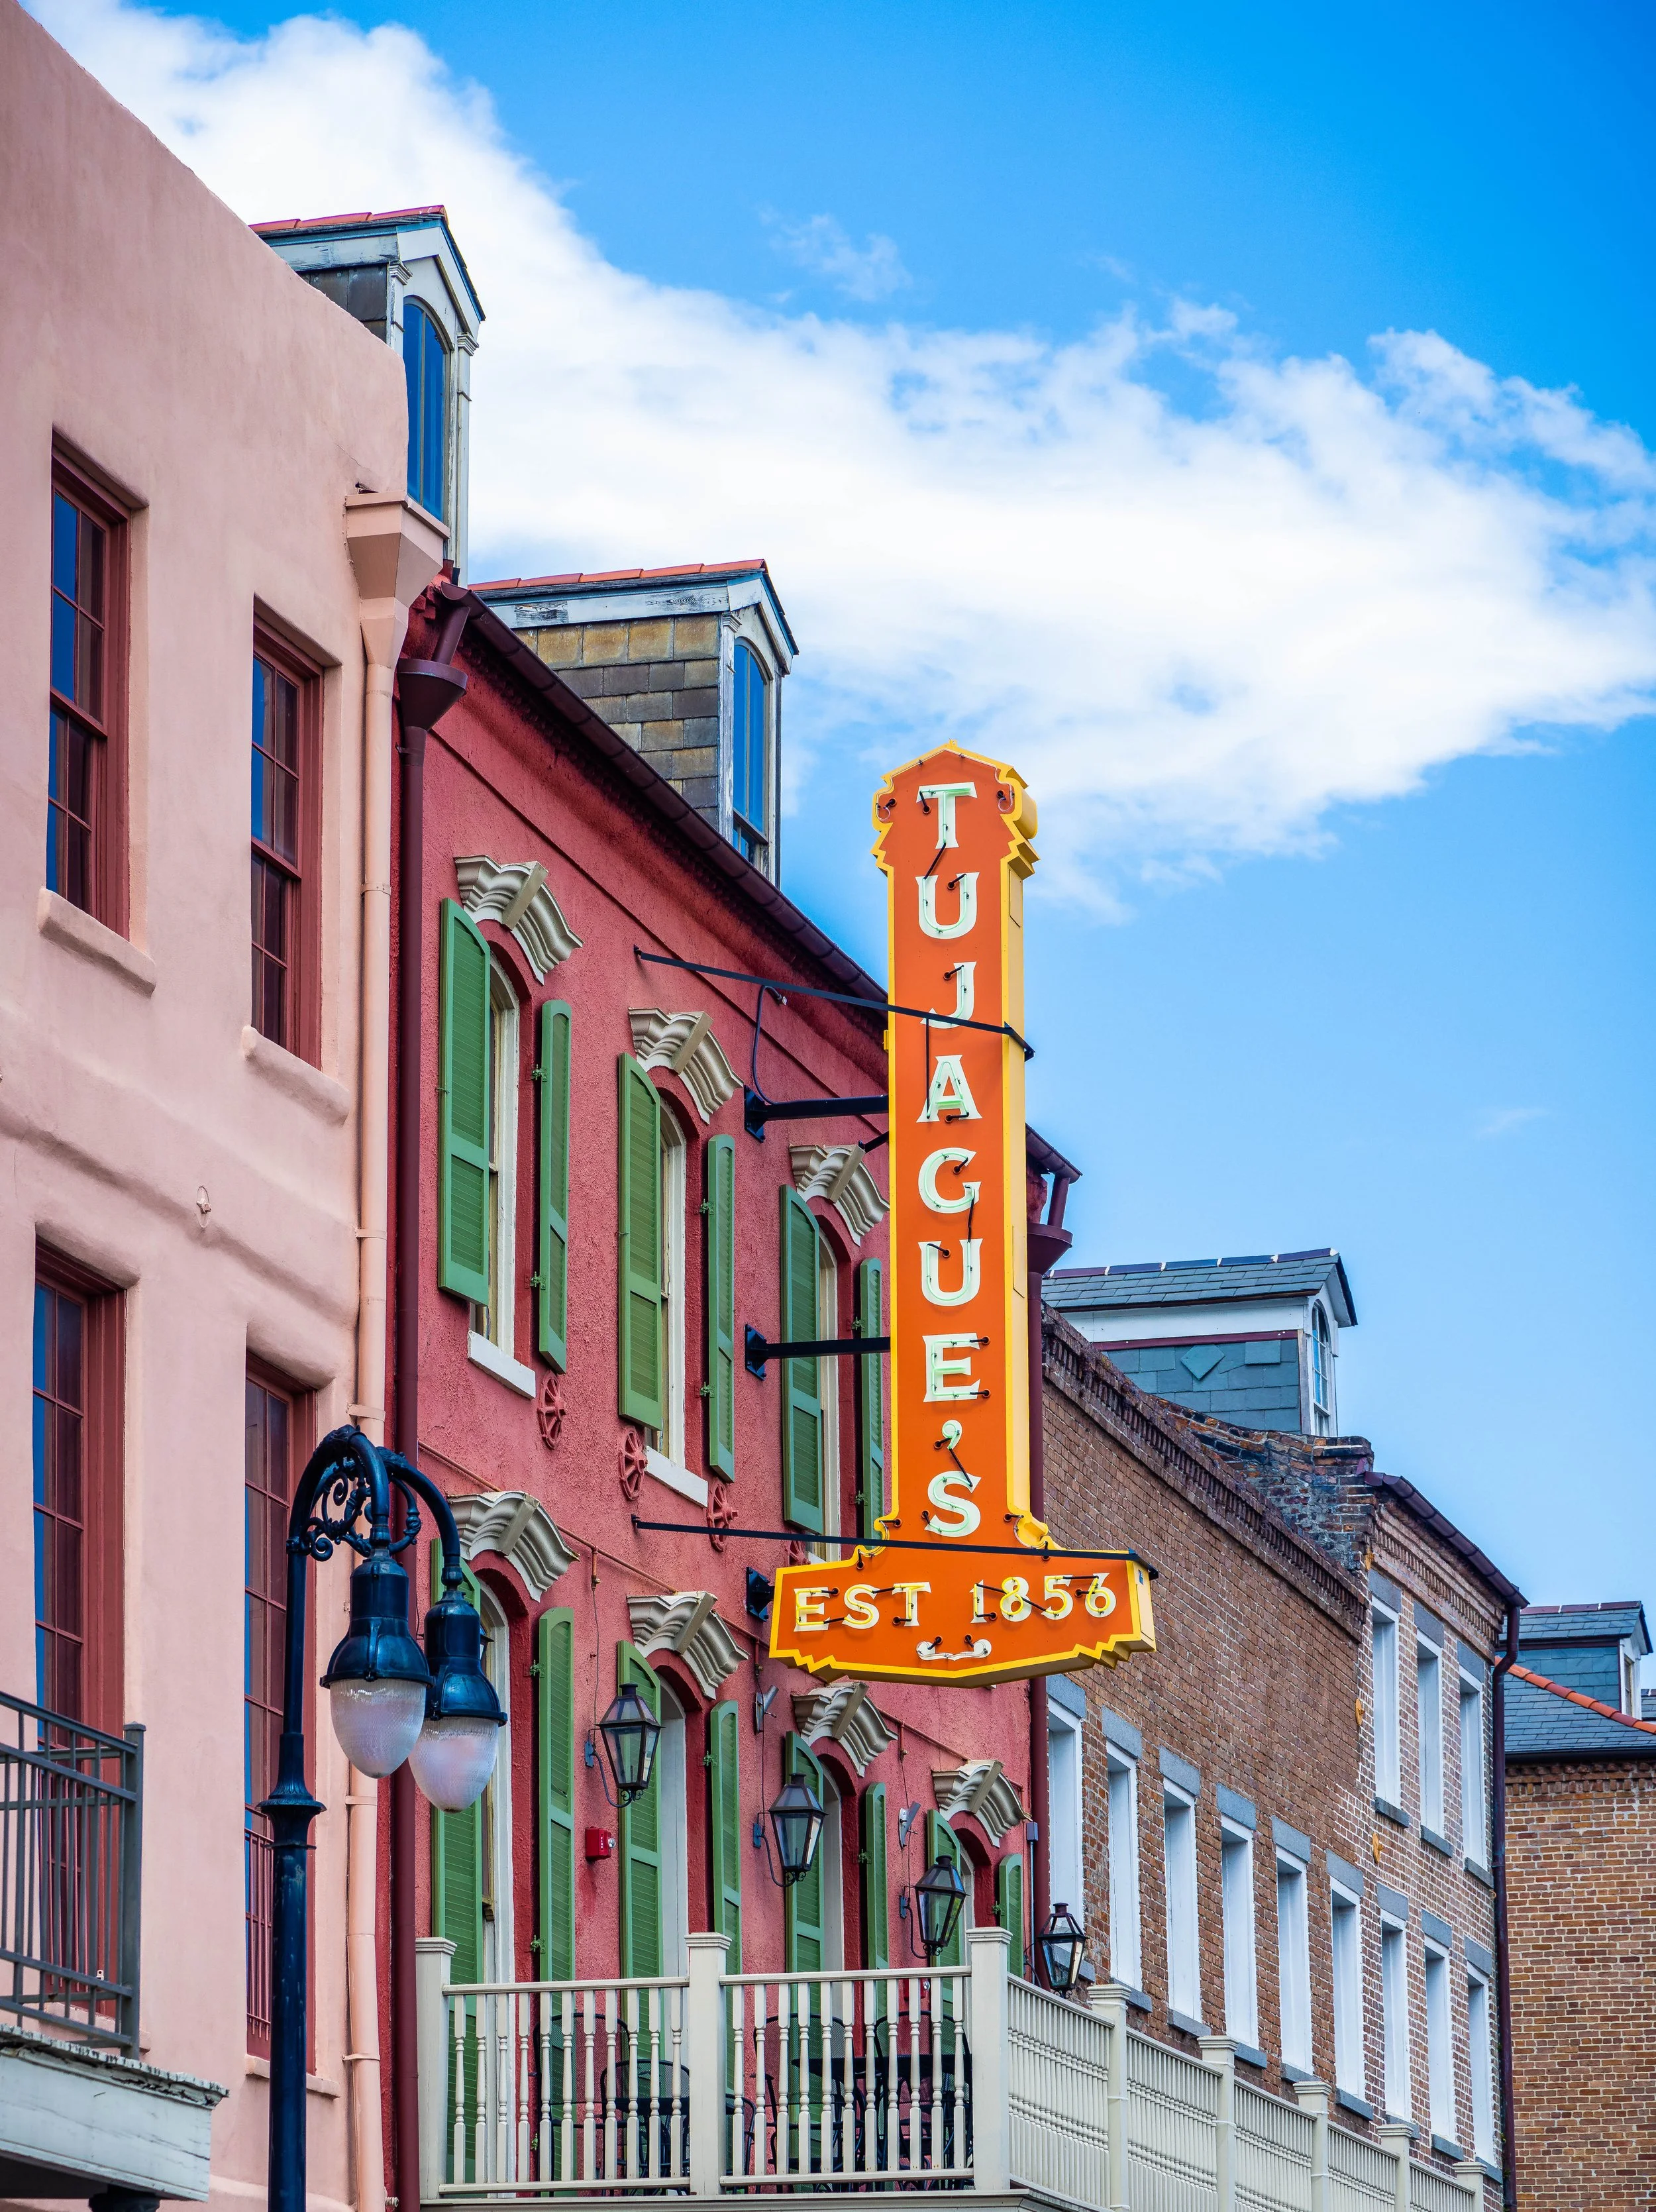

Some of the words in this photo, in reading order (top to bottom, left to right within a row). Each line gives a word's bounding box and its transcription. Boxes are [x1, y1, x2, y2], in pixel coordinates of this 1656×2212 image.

[915, 781, 984, 1538] TUJAGUE'S
[794, 1581, 931, 1632] EST
[969, 1572, 1116, 1624] 1856
